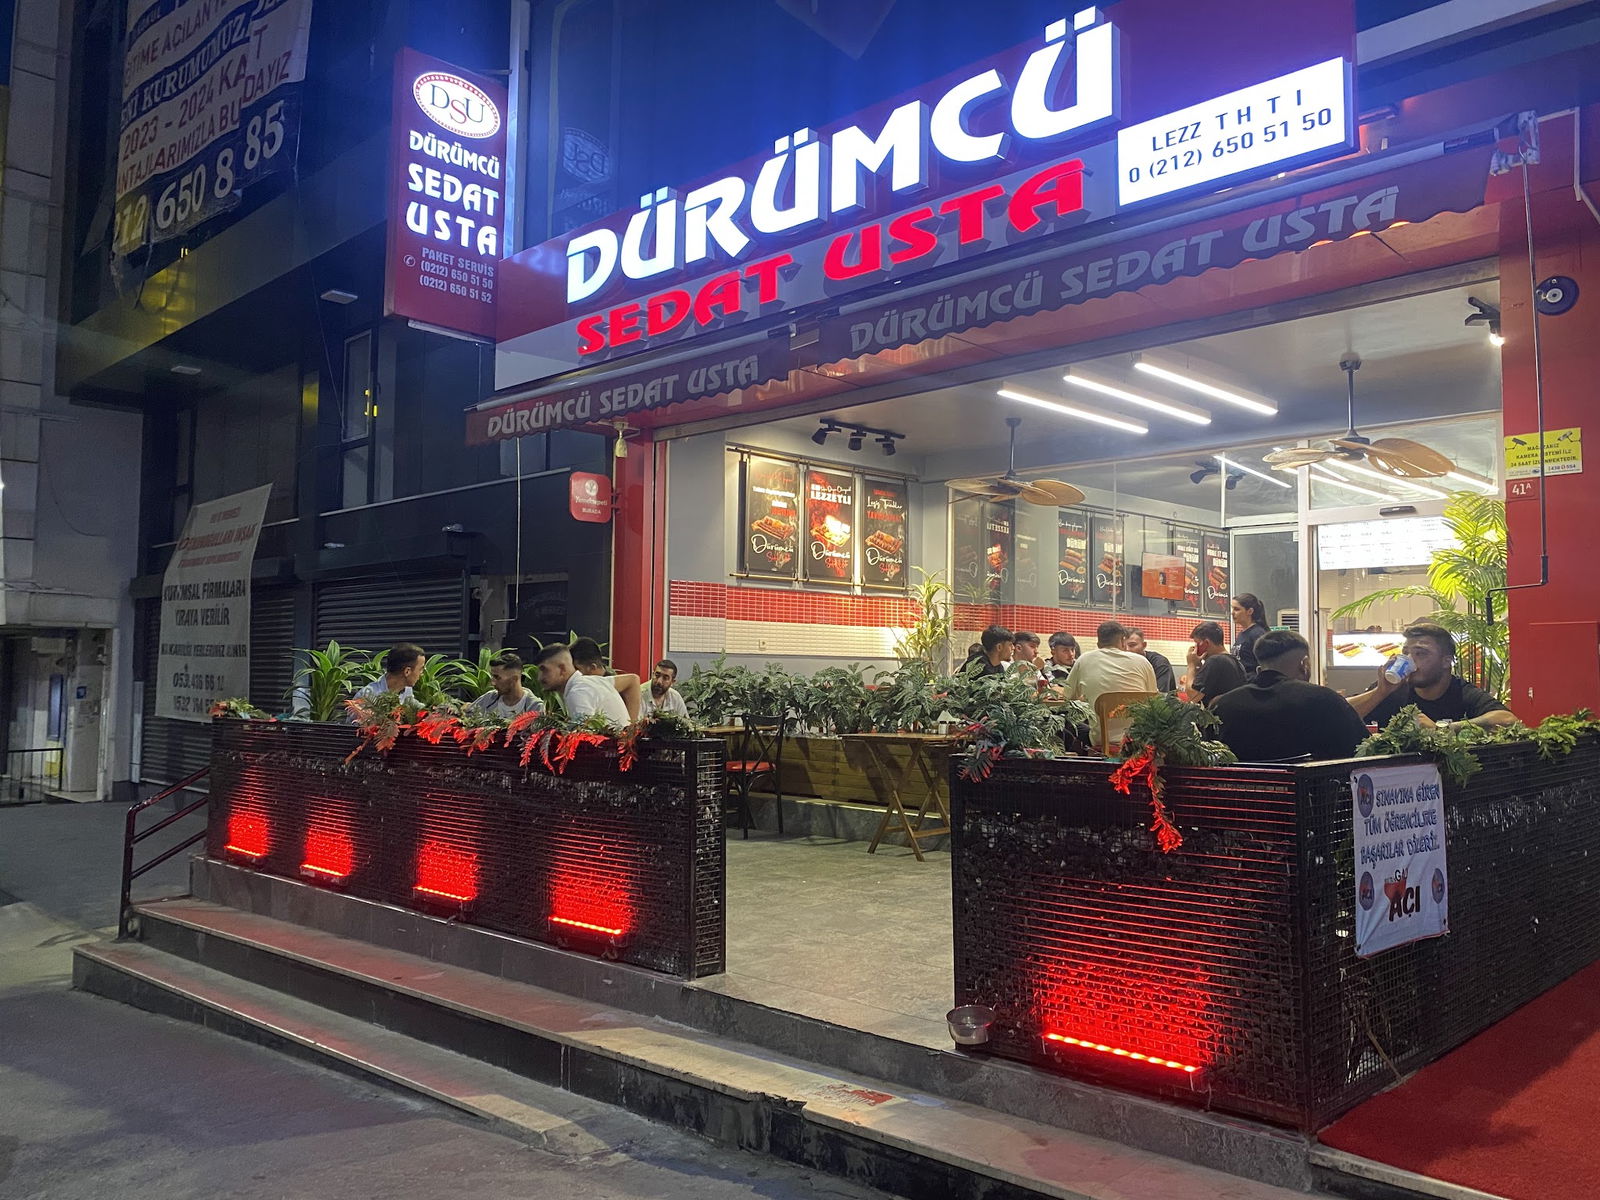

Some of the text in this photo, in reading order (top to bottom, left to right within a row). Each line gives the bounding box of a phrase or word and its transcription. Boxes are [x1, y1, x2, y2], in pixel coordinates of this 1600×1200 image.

[122, 116, 157, 162] 2023
[179, 80, 214, 130] 2024
[430, 83, 484, 125] DSU
[156, 163, 206, 229] 650
[243, 99, 285, 170] 85
[409, 130, 500, 180] DÜRÜMCÜ
[566, 6, 1112, 303] DÜRÜMCÜ
[1128, 107, 1332, 183] 0 (212) 650 51 50
[408, 162, 499, 217] SEDAT
[405, 201, 498, 257] USTA
[576, 158, 1085, 356] SEDAT USTA
[419, 274, 493, 304] (0212) 650 51 52
[420, 259, 494, 290] (0212) 650 51 50
[422, 247, 495, 278] PAKET SERVİS
[849, 186, 1399, 352] DÜRÜMCÜ SEDAT USTA
[487, 355, 760, 438] DÜRÜMCÜ SEDAT USTA
[1364, 816, 1382, 836] TÜM
